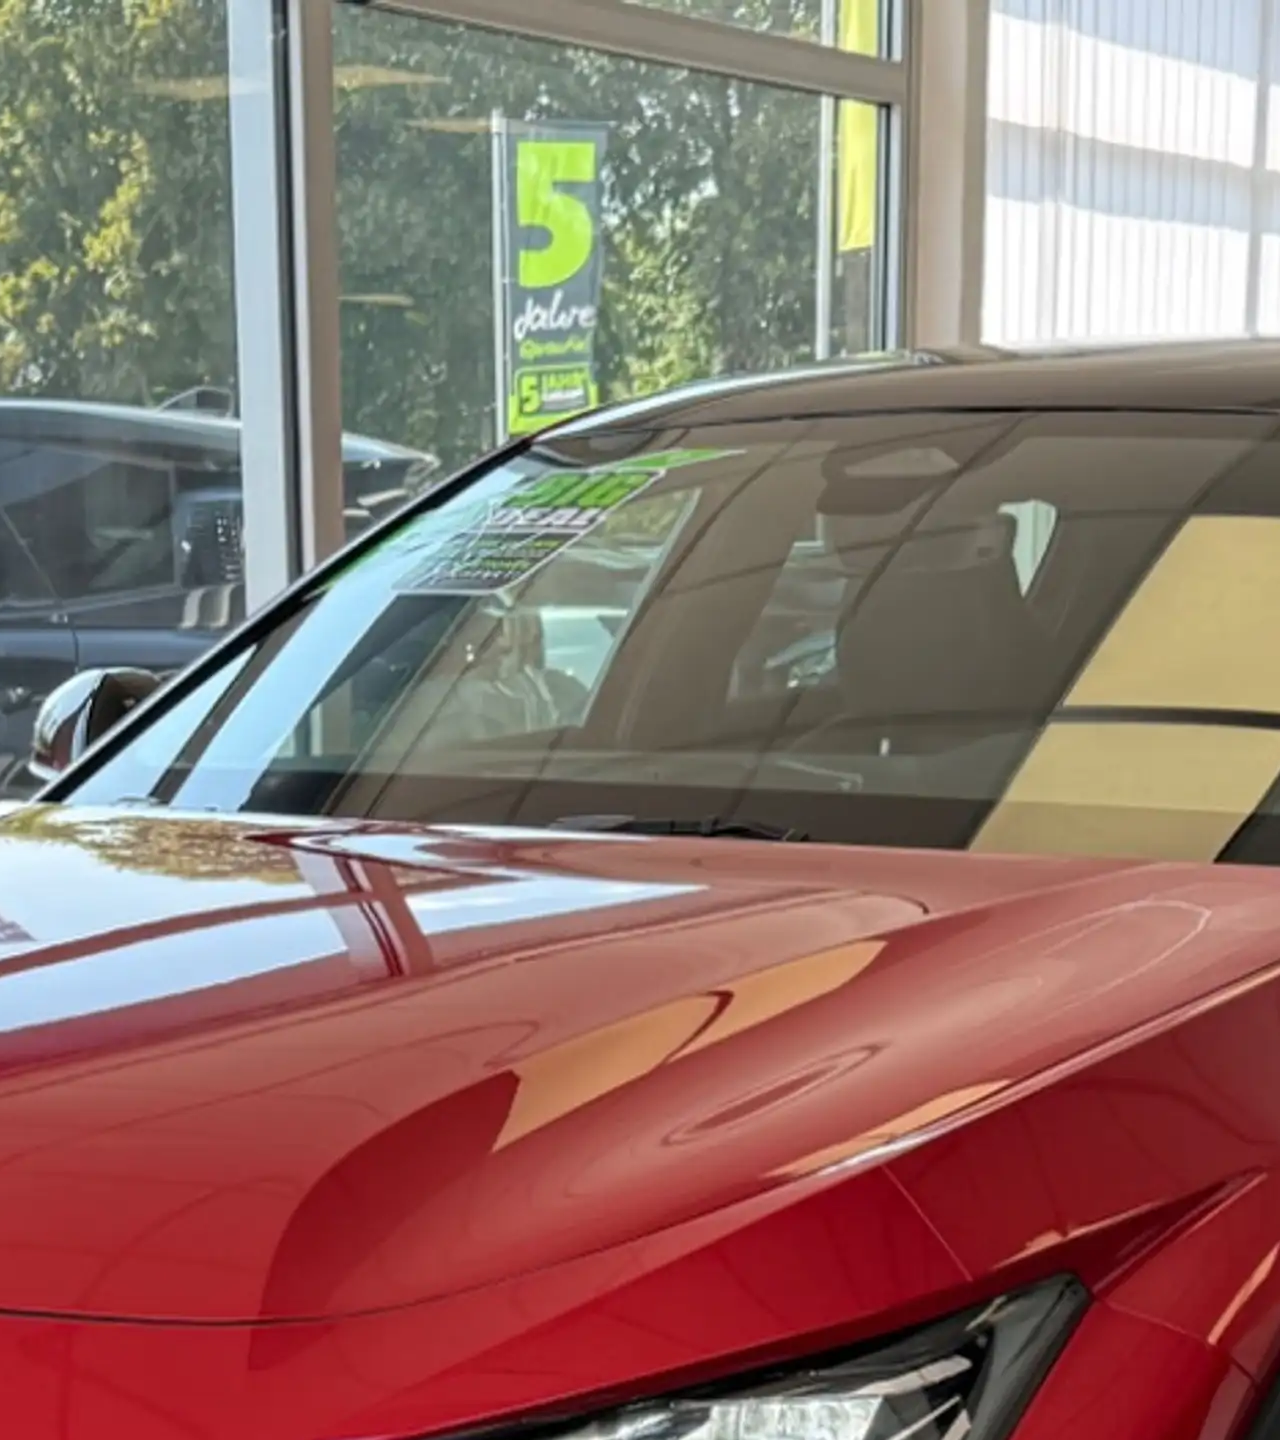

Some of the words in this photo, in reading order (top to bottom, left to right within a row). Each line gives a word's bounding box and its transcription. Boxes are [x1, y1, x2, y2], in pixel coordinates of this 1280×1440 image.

[517, 142, 596, 288] 5
[514, 288, 597, 340] Jahre
[521, 376, 540, 413] 5
